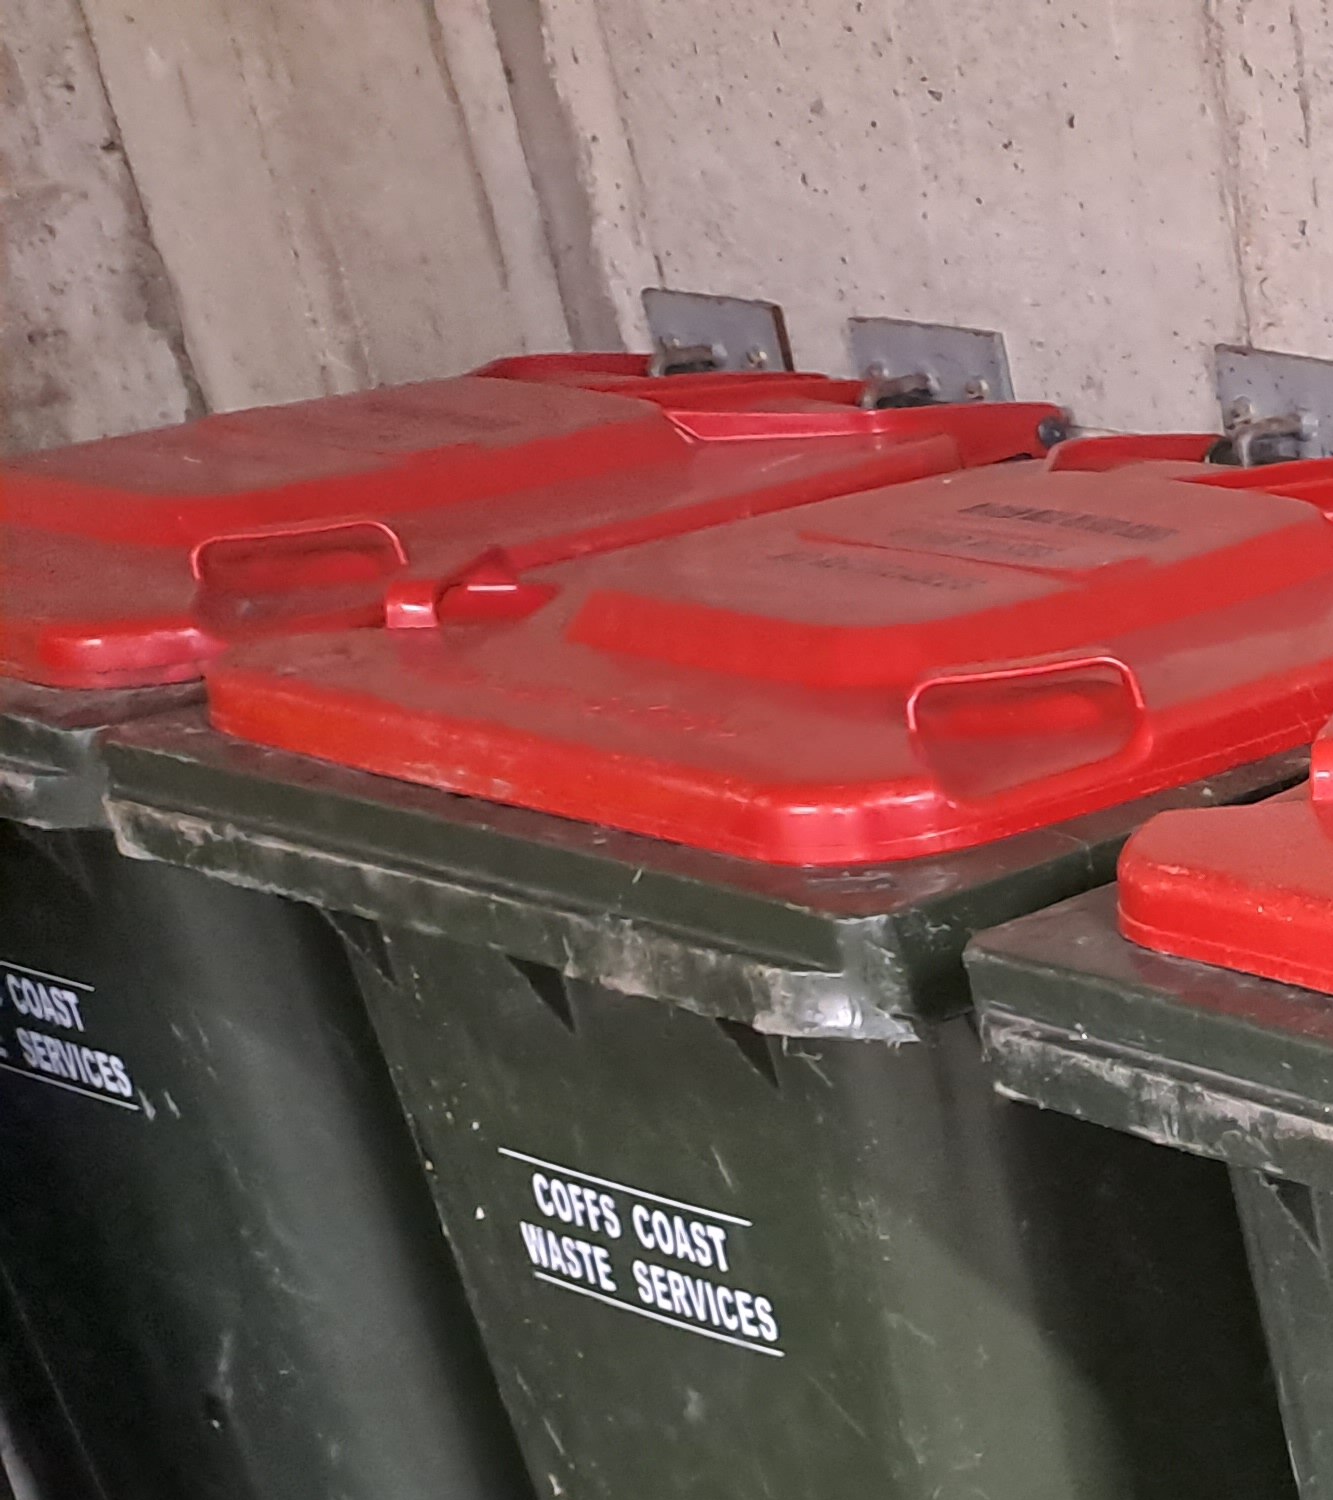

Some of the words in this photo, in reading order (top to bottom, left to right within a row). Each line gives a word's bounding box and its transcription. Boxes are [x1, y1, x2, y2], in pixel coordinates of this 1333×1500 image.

[6, 973, 85, 1032] COAST
[16, 1027, 133, 1097] SERVICES
[532, 1173, 622, 1239] COFFS
[632, 1204, 729, 1272] COAST
[520, 1221, 617, 1292] WASTE
[632, 1260, 778, 1342] SERVICES
